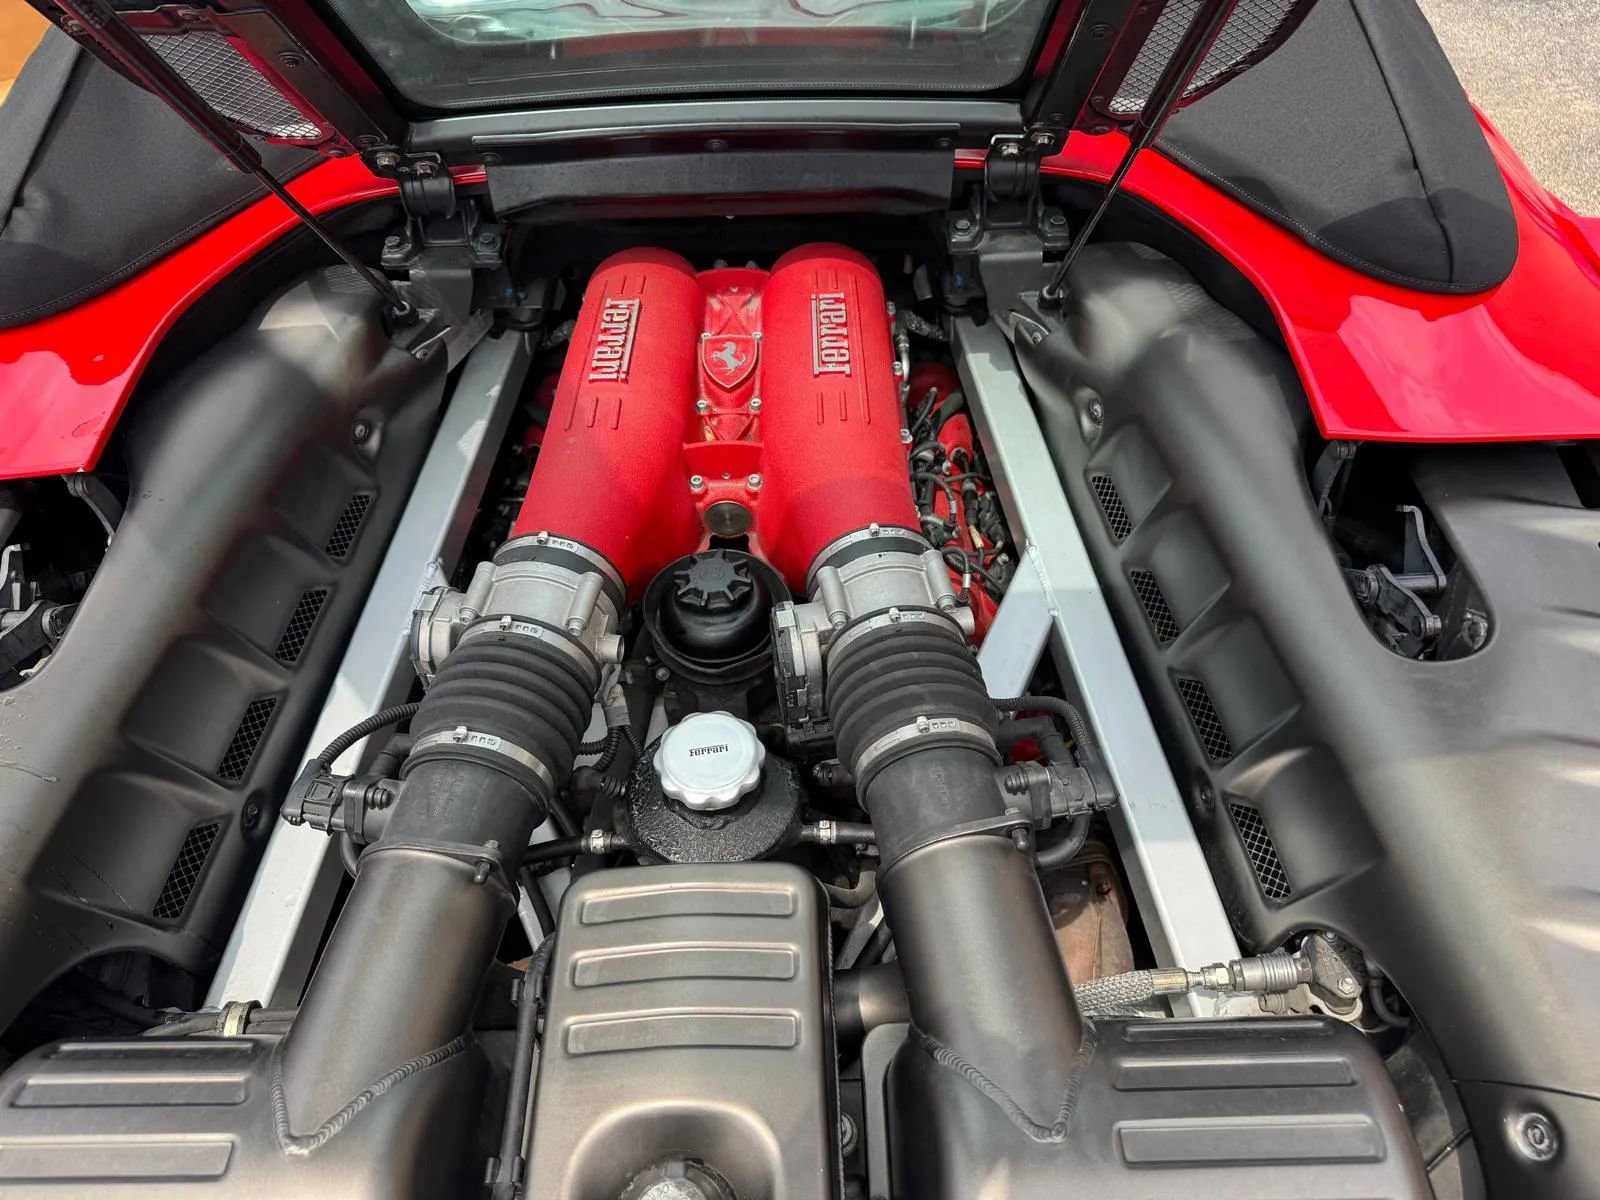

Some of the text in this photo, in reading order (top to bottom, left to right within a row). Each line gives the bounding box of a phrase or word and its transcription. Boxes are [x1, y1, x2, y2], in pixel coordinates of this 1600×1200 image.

[589, 298, 641, 383] Ferrari
[811, 292, 851, 375] Ferrari
[689, 744, 728, 756] Ferrari
